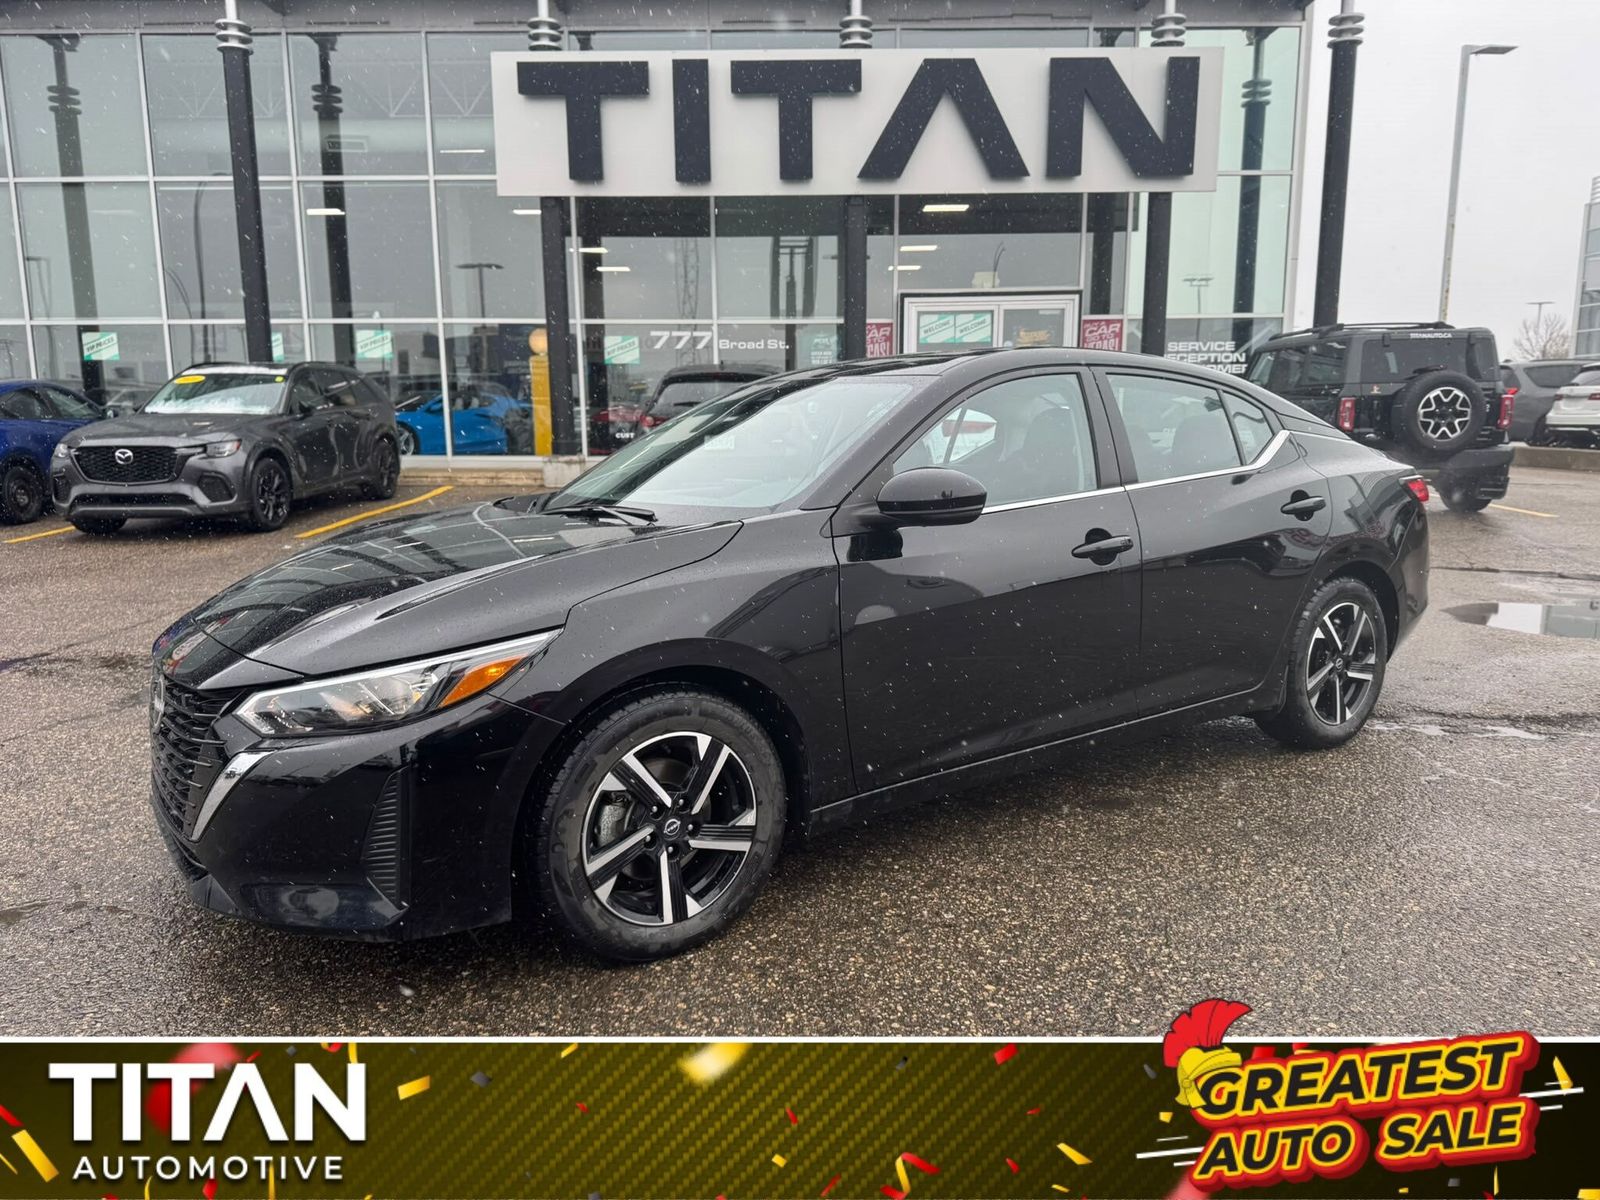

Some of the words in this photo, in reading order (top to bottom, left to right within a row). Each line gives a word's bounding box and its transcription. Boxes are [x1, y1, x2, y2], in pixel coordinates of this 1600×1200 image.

[517, 56, 1200, 183] TITAN
[866, 327, 891, 339] AR
[923, 320, 950, 335] WELCOME
[960, 318, 987, 334] WELCOME
[1085, 323, 1121, 337] CAR
[650, 331, 712, 349] 777
[718, 339, 765, 349] Broad
[767, 339, 790, 349] St.
[1167, 341, 1236, 352] SERVICE
[866, 341, 891, 358] GAS!
[1163, 352, 1246, 363] ECEPTION
